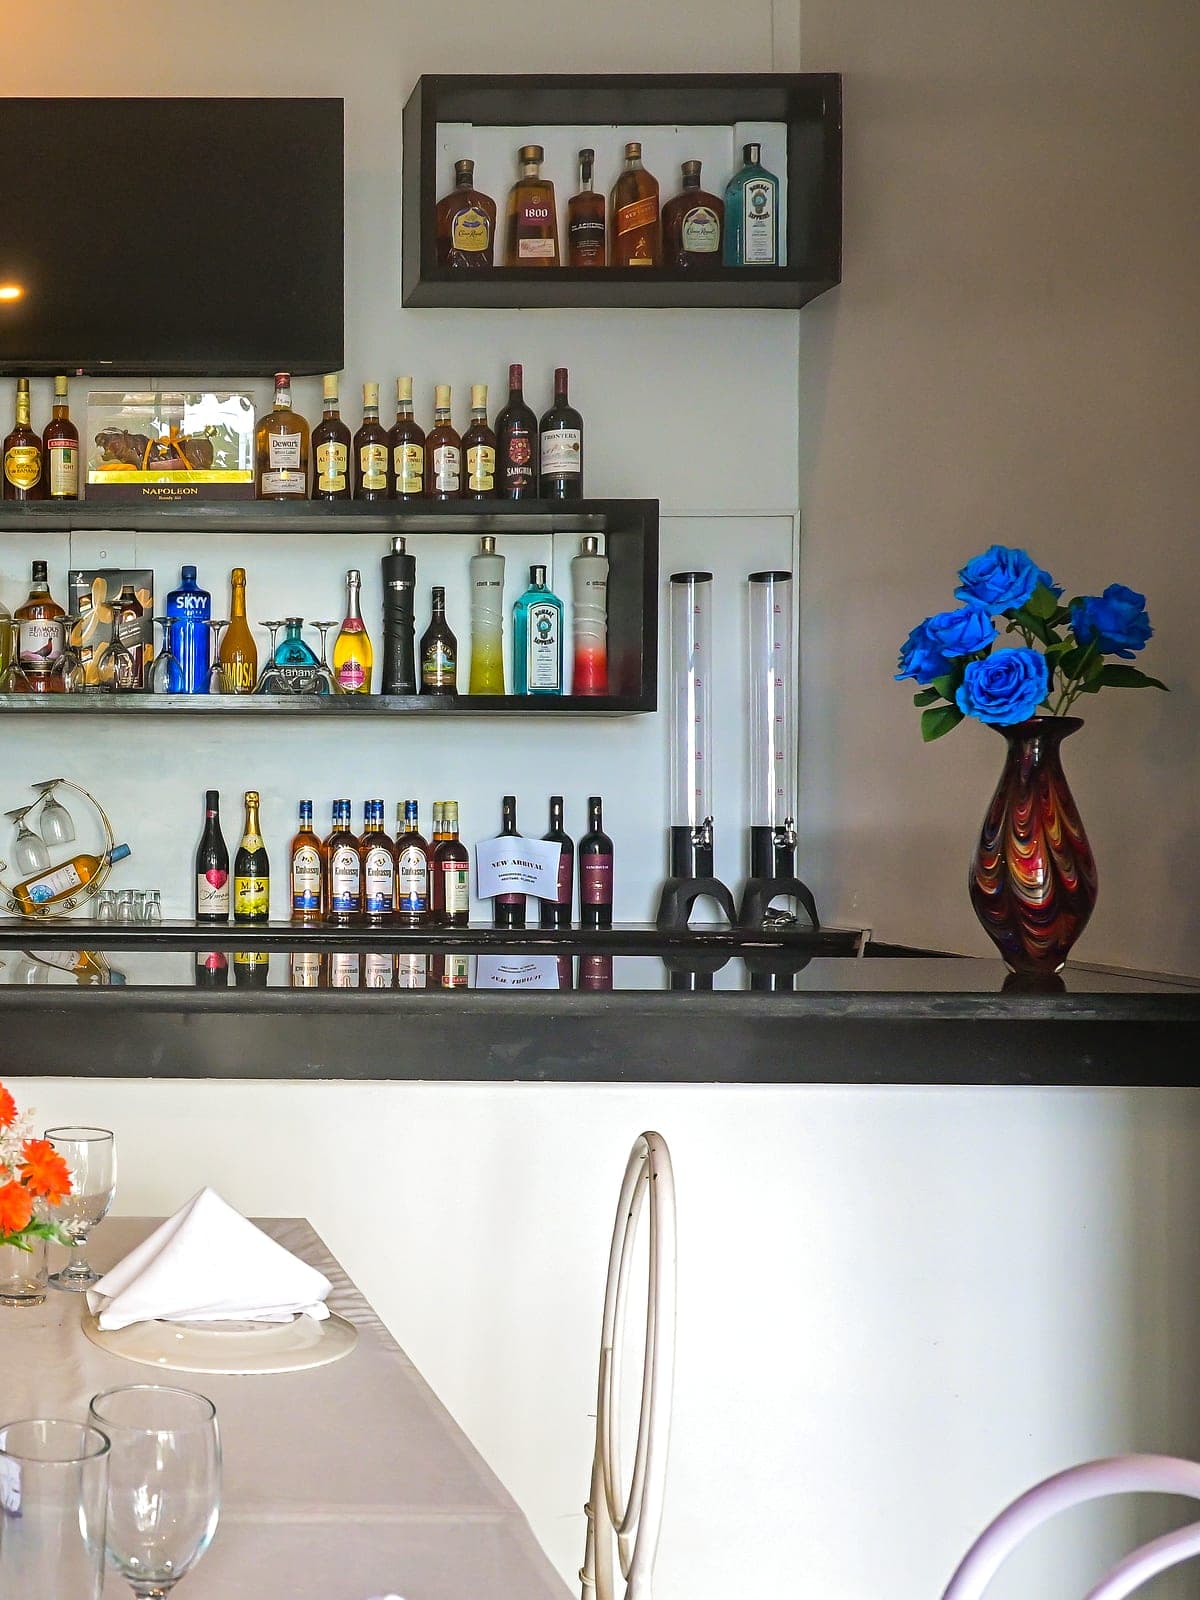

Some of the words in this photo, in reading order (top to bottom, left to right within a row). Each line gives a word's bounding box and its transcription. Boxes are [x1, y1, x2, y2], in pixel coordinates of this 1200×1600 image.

[525, 208, 548, 218] 1800
[142, 487, 198, 495] NAPOLEON
[175, 597, 208, 609] SKYY
[491, 860, 507, 868] NEW
[511, 859, 544, 871] ARRIVAL
